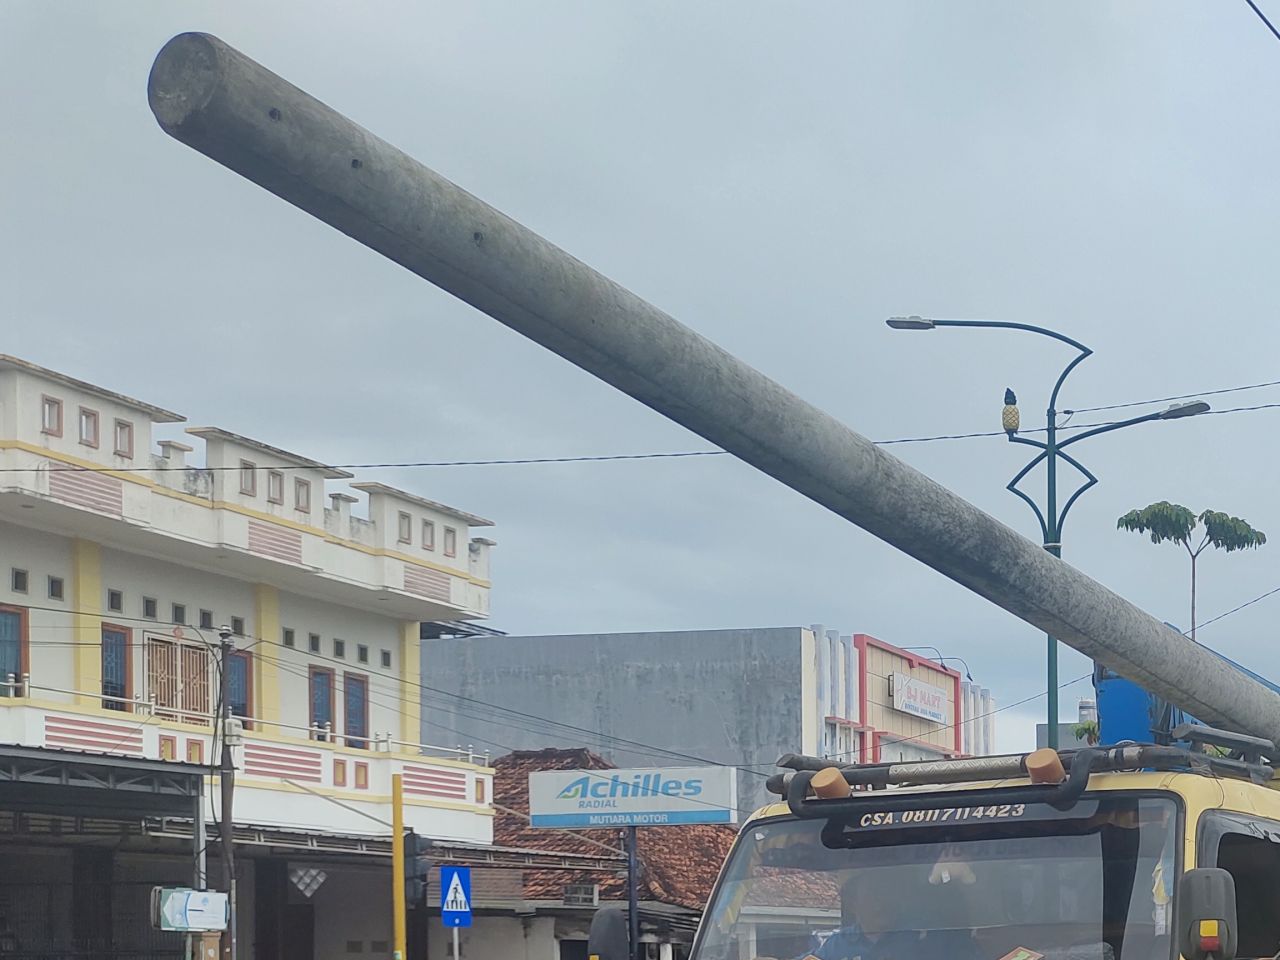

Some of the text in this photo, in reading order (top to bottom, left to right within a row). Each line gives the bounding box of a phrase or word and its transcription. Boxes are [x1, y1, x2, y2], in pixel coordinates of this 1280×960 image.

[557, 774, 703, 799] Achilles
[578, 800, 617, 809] RADIAL
[589, 814, 668, 825] MUTIARA MOTOR
